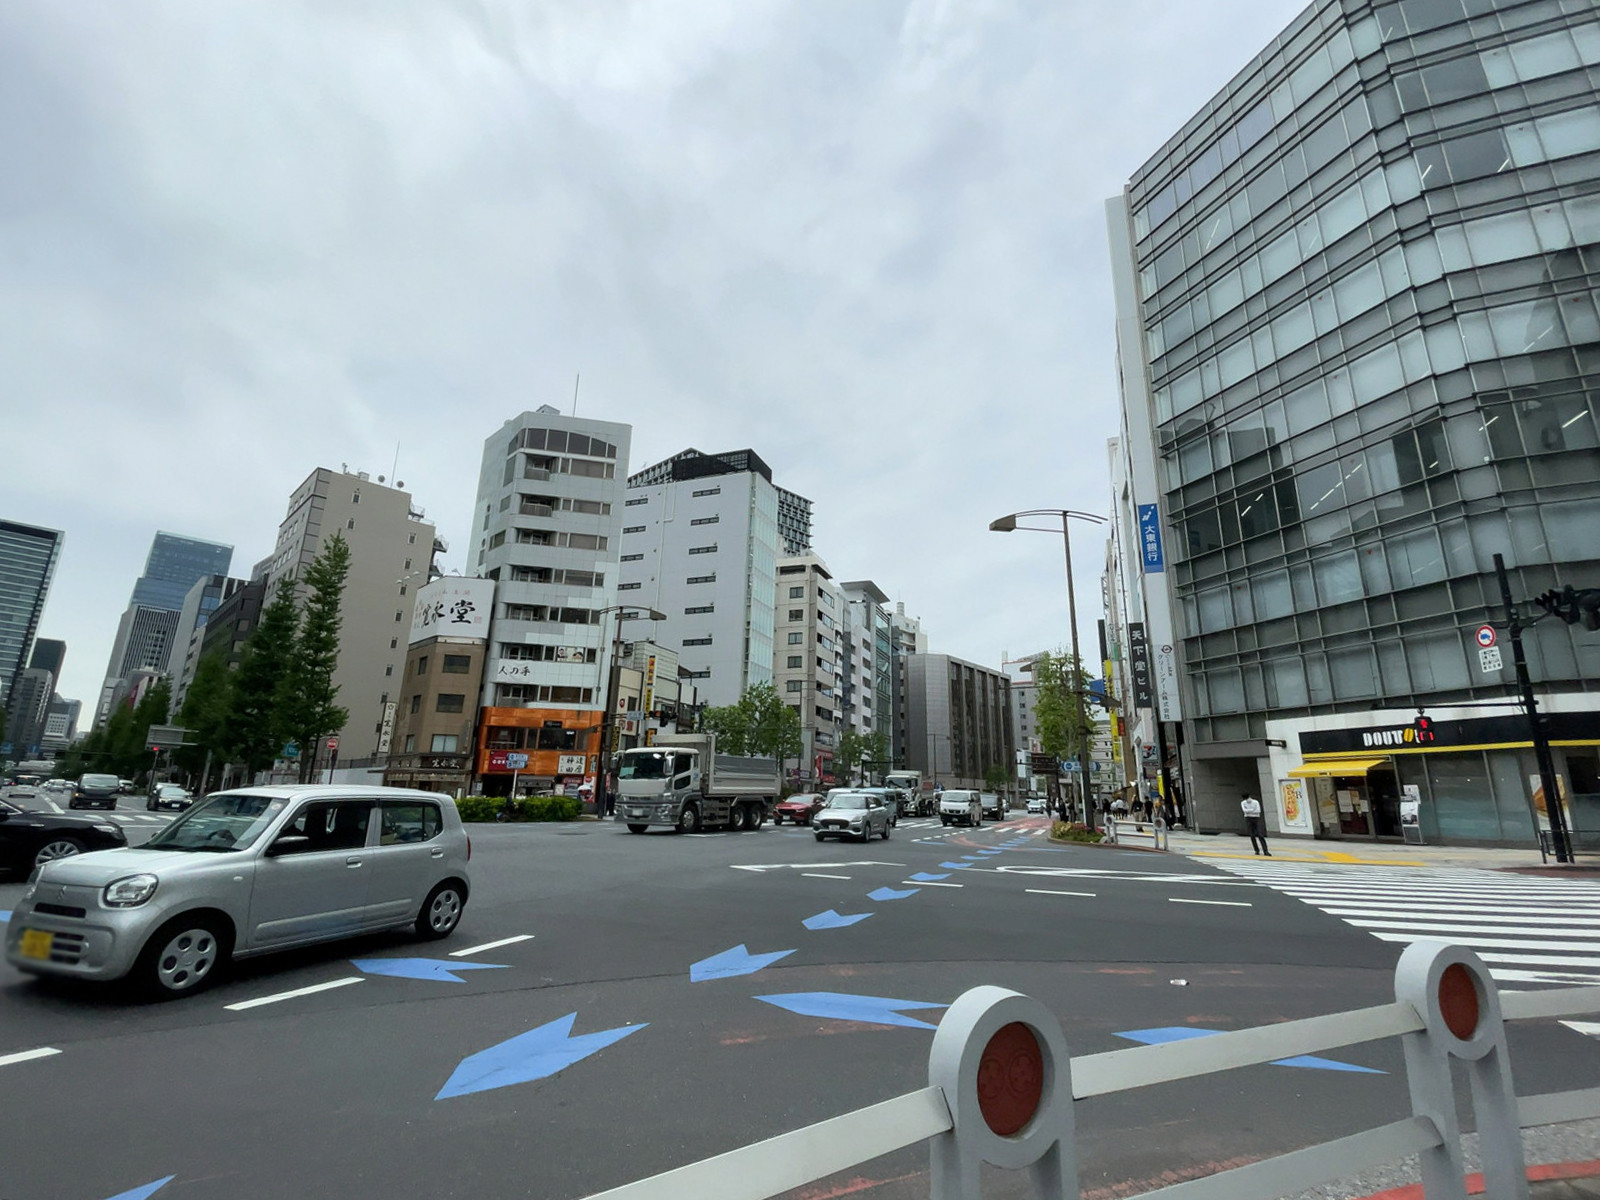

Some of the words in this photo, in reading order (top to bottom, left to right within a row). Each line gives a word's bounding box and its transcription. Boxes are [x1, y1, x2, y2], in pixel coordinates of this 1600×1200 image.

[1144, 525, 1158, 562] 大東銀行
[1132, 630, 1149, 700] 天下堂ビル
